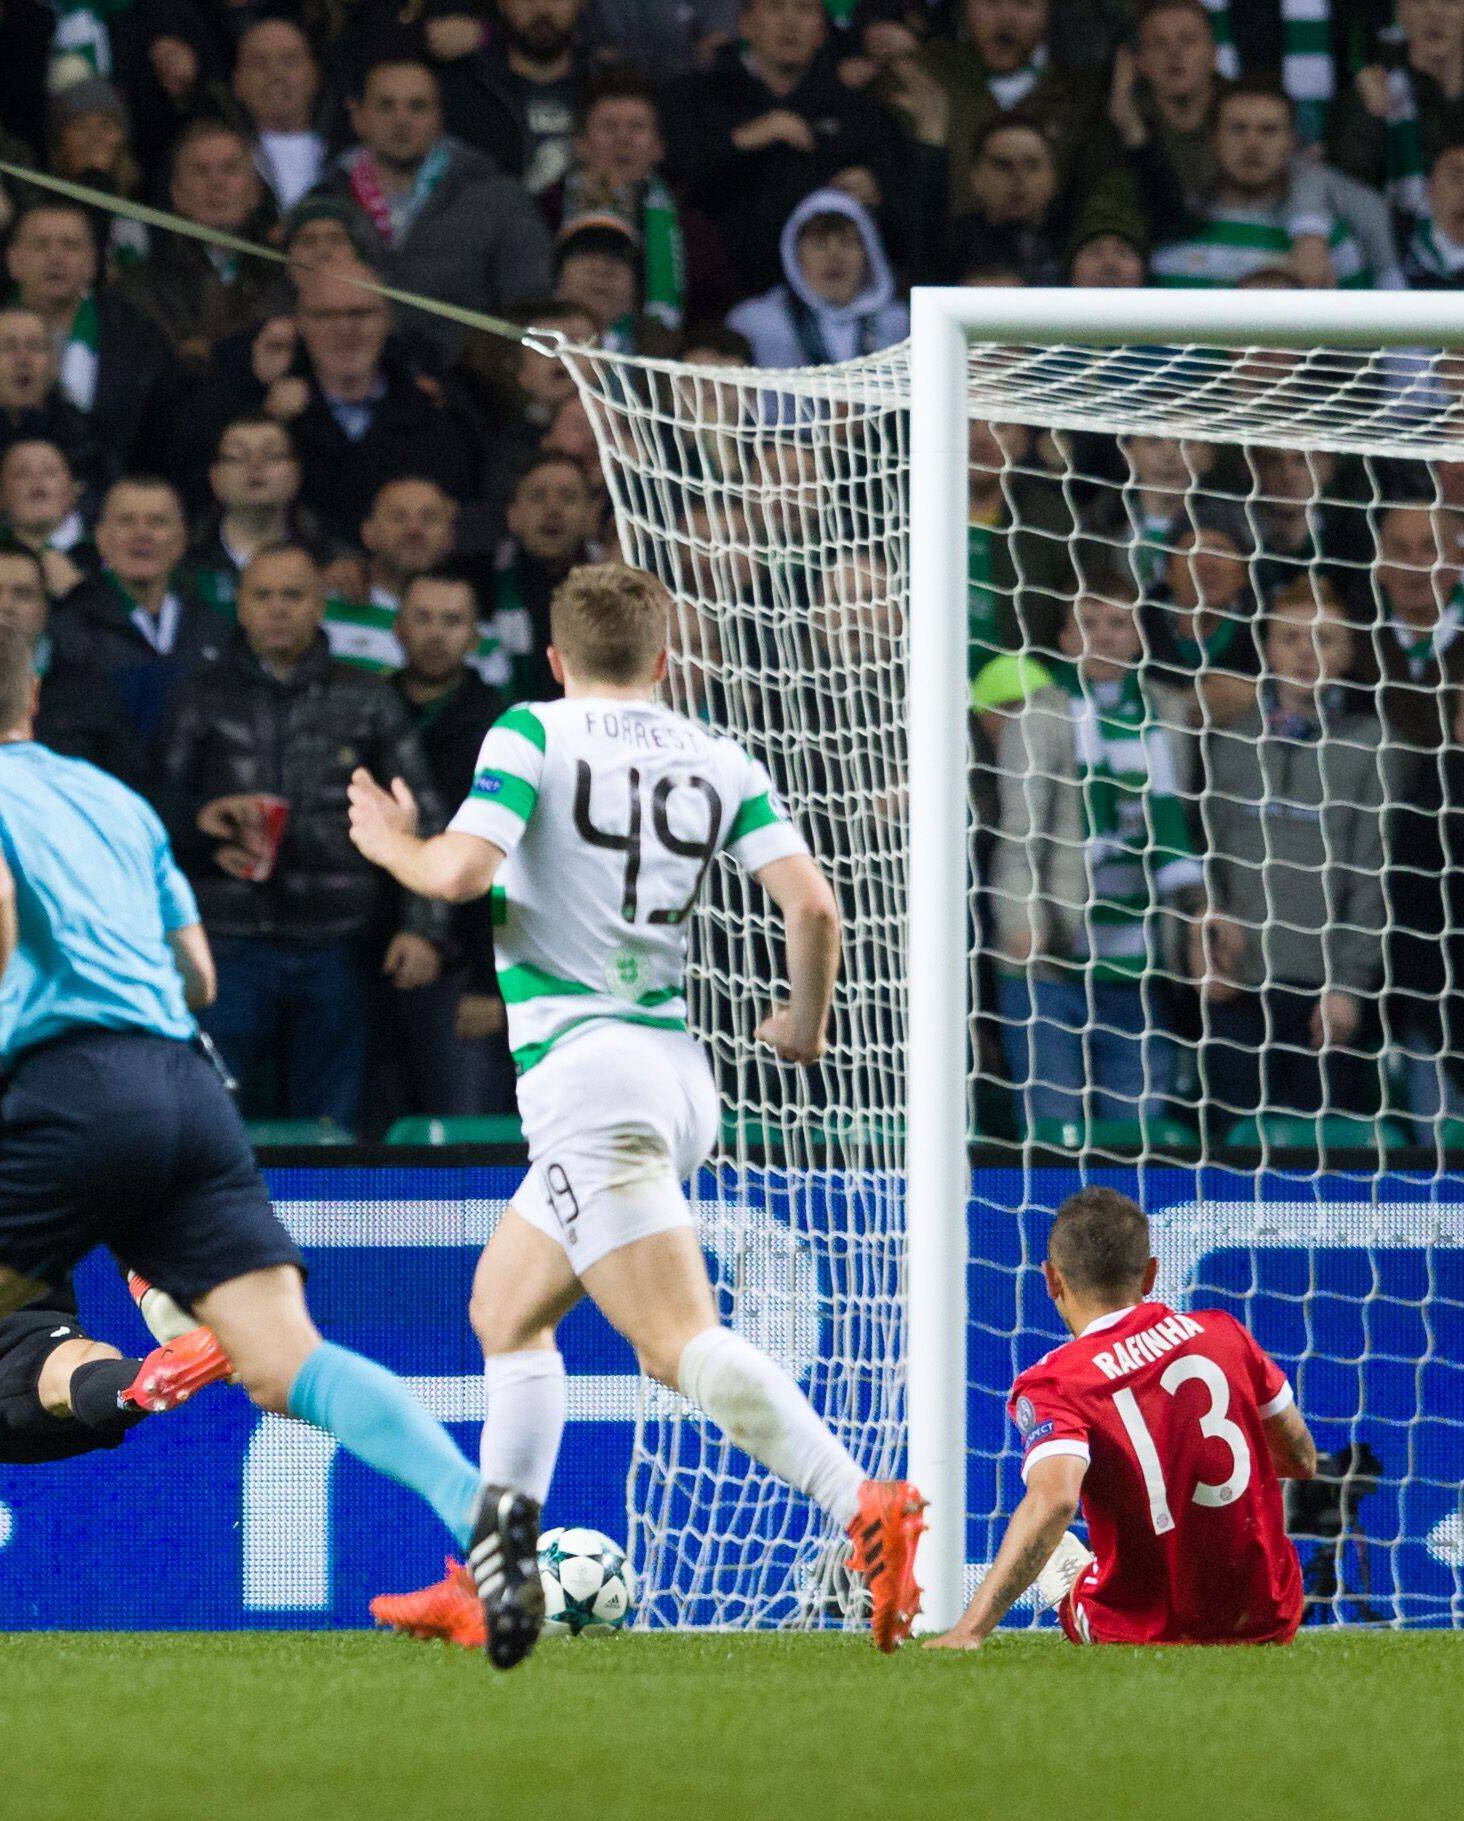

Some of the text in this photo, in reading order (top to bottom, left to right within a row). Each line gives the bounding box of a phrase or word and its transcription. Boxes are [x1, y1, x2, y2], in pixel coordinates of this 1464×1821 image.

[586, 712, 698, 752] FORREST
[574, 759, 722, 923] 49
[1092, 1312, 1205, 1381] RAFINHA
[1113, 1354, 1251, 1536] 13
